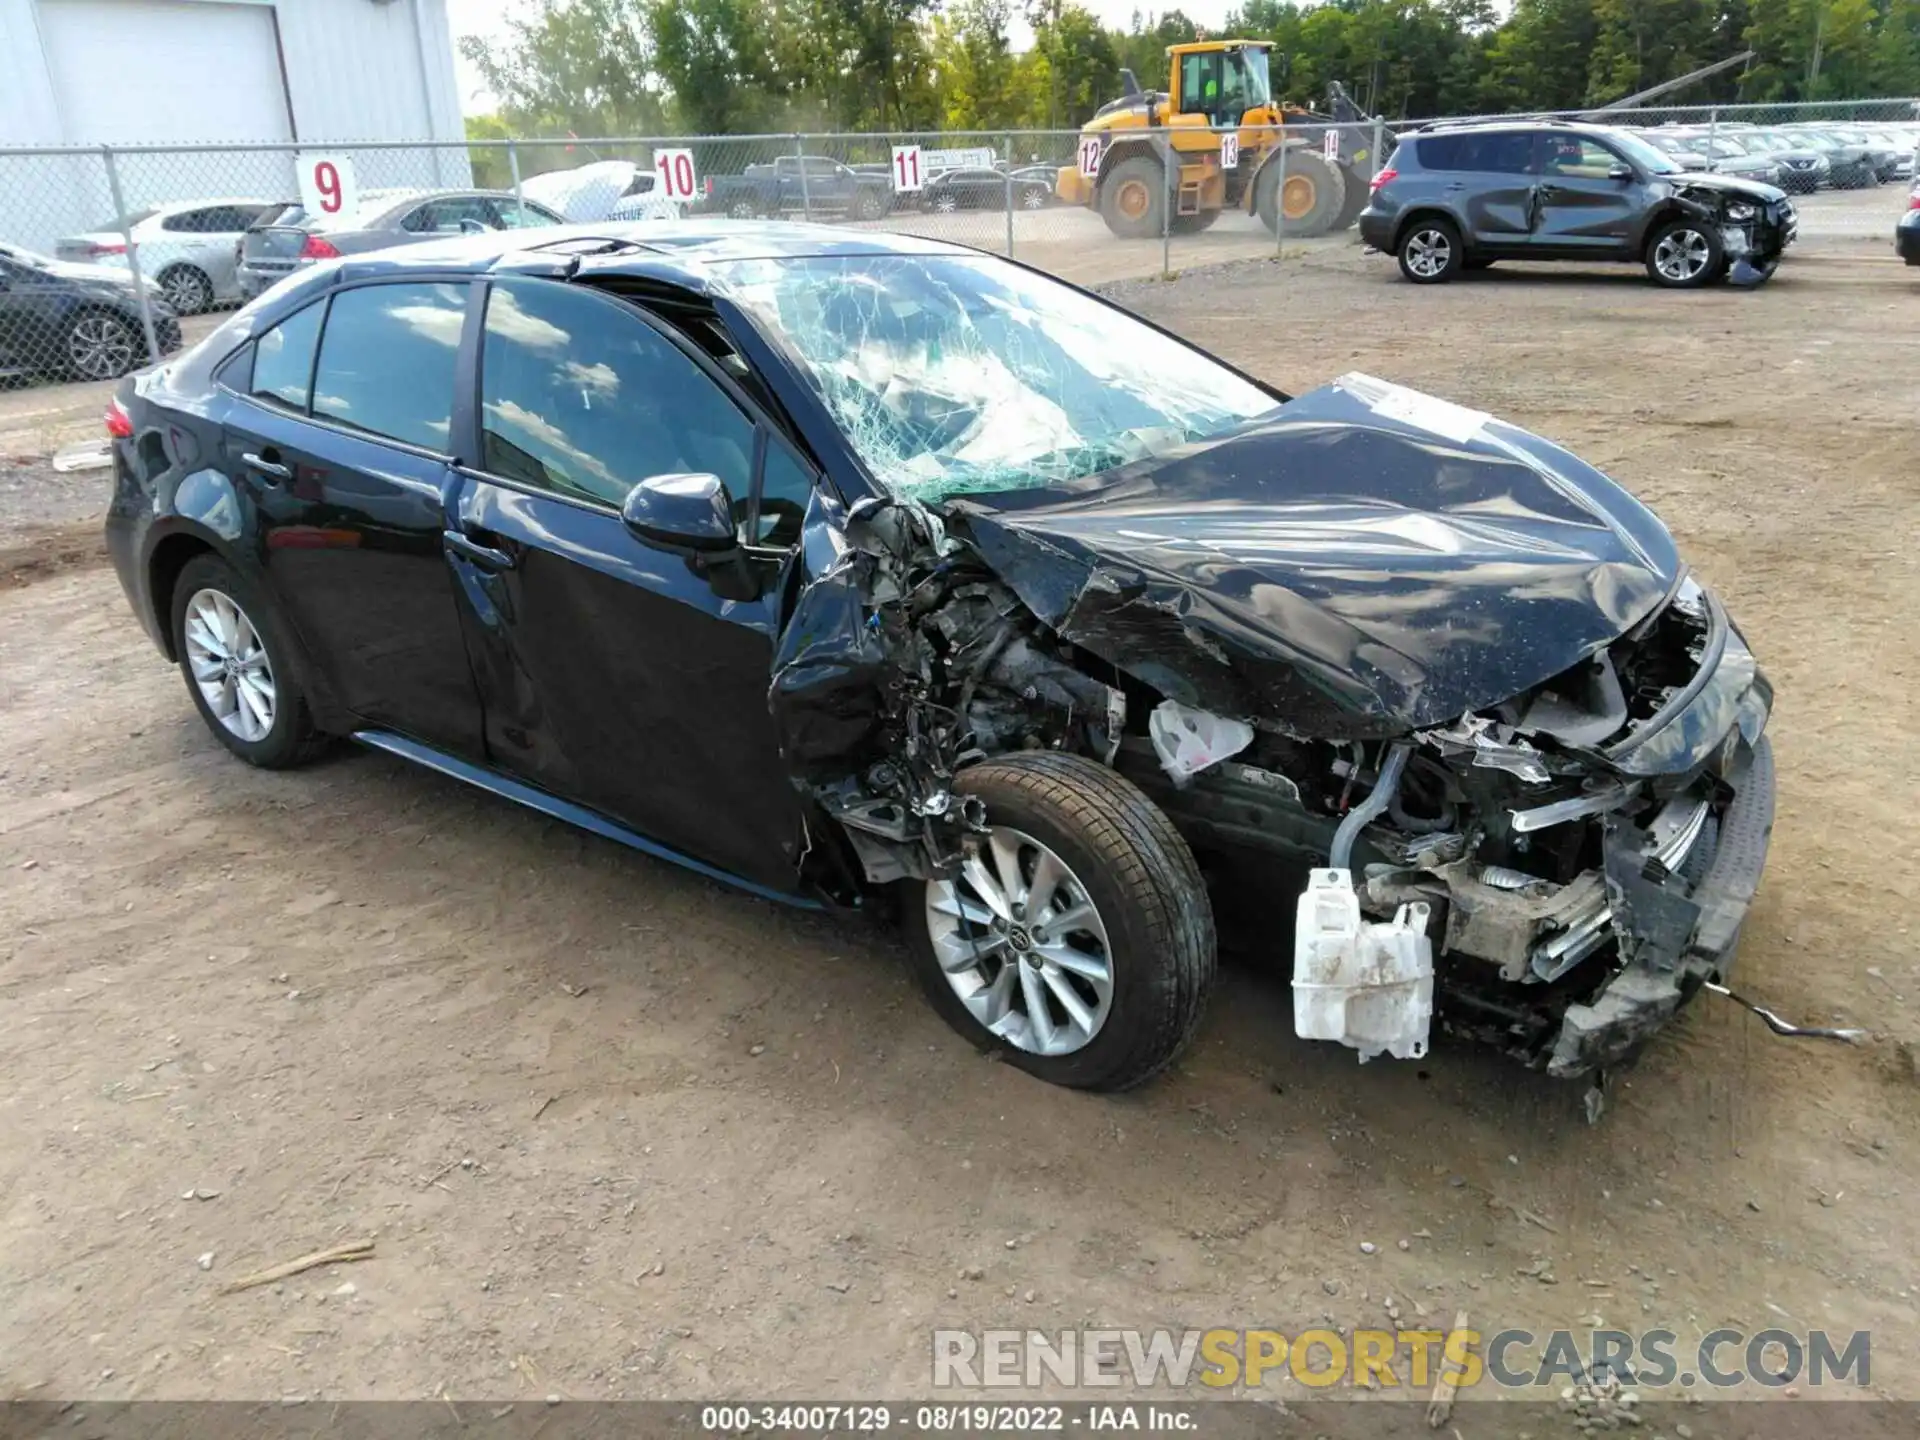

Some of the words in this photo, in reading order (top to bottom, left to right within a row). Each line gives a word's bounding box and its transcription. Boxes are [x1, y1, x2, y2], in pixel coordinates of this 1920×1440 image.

[895, 150, 918, 187] 11
[1082, 142, 1099, 173] 12
[1223, 135, 1238, 165] 13
[315, 161, 342, 213] 9
[658, 154, 693, 196] 10
